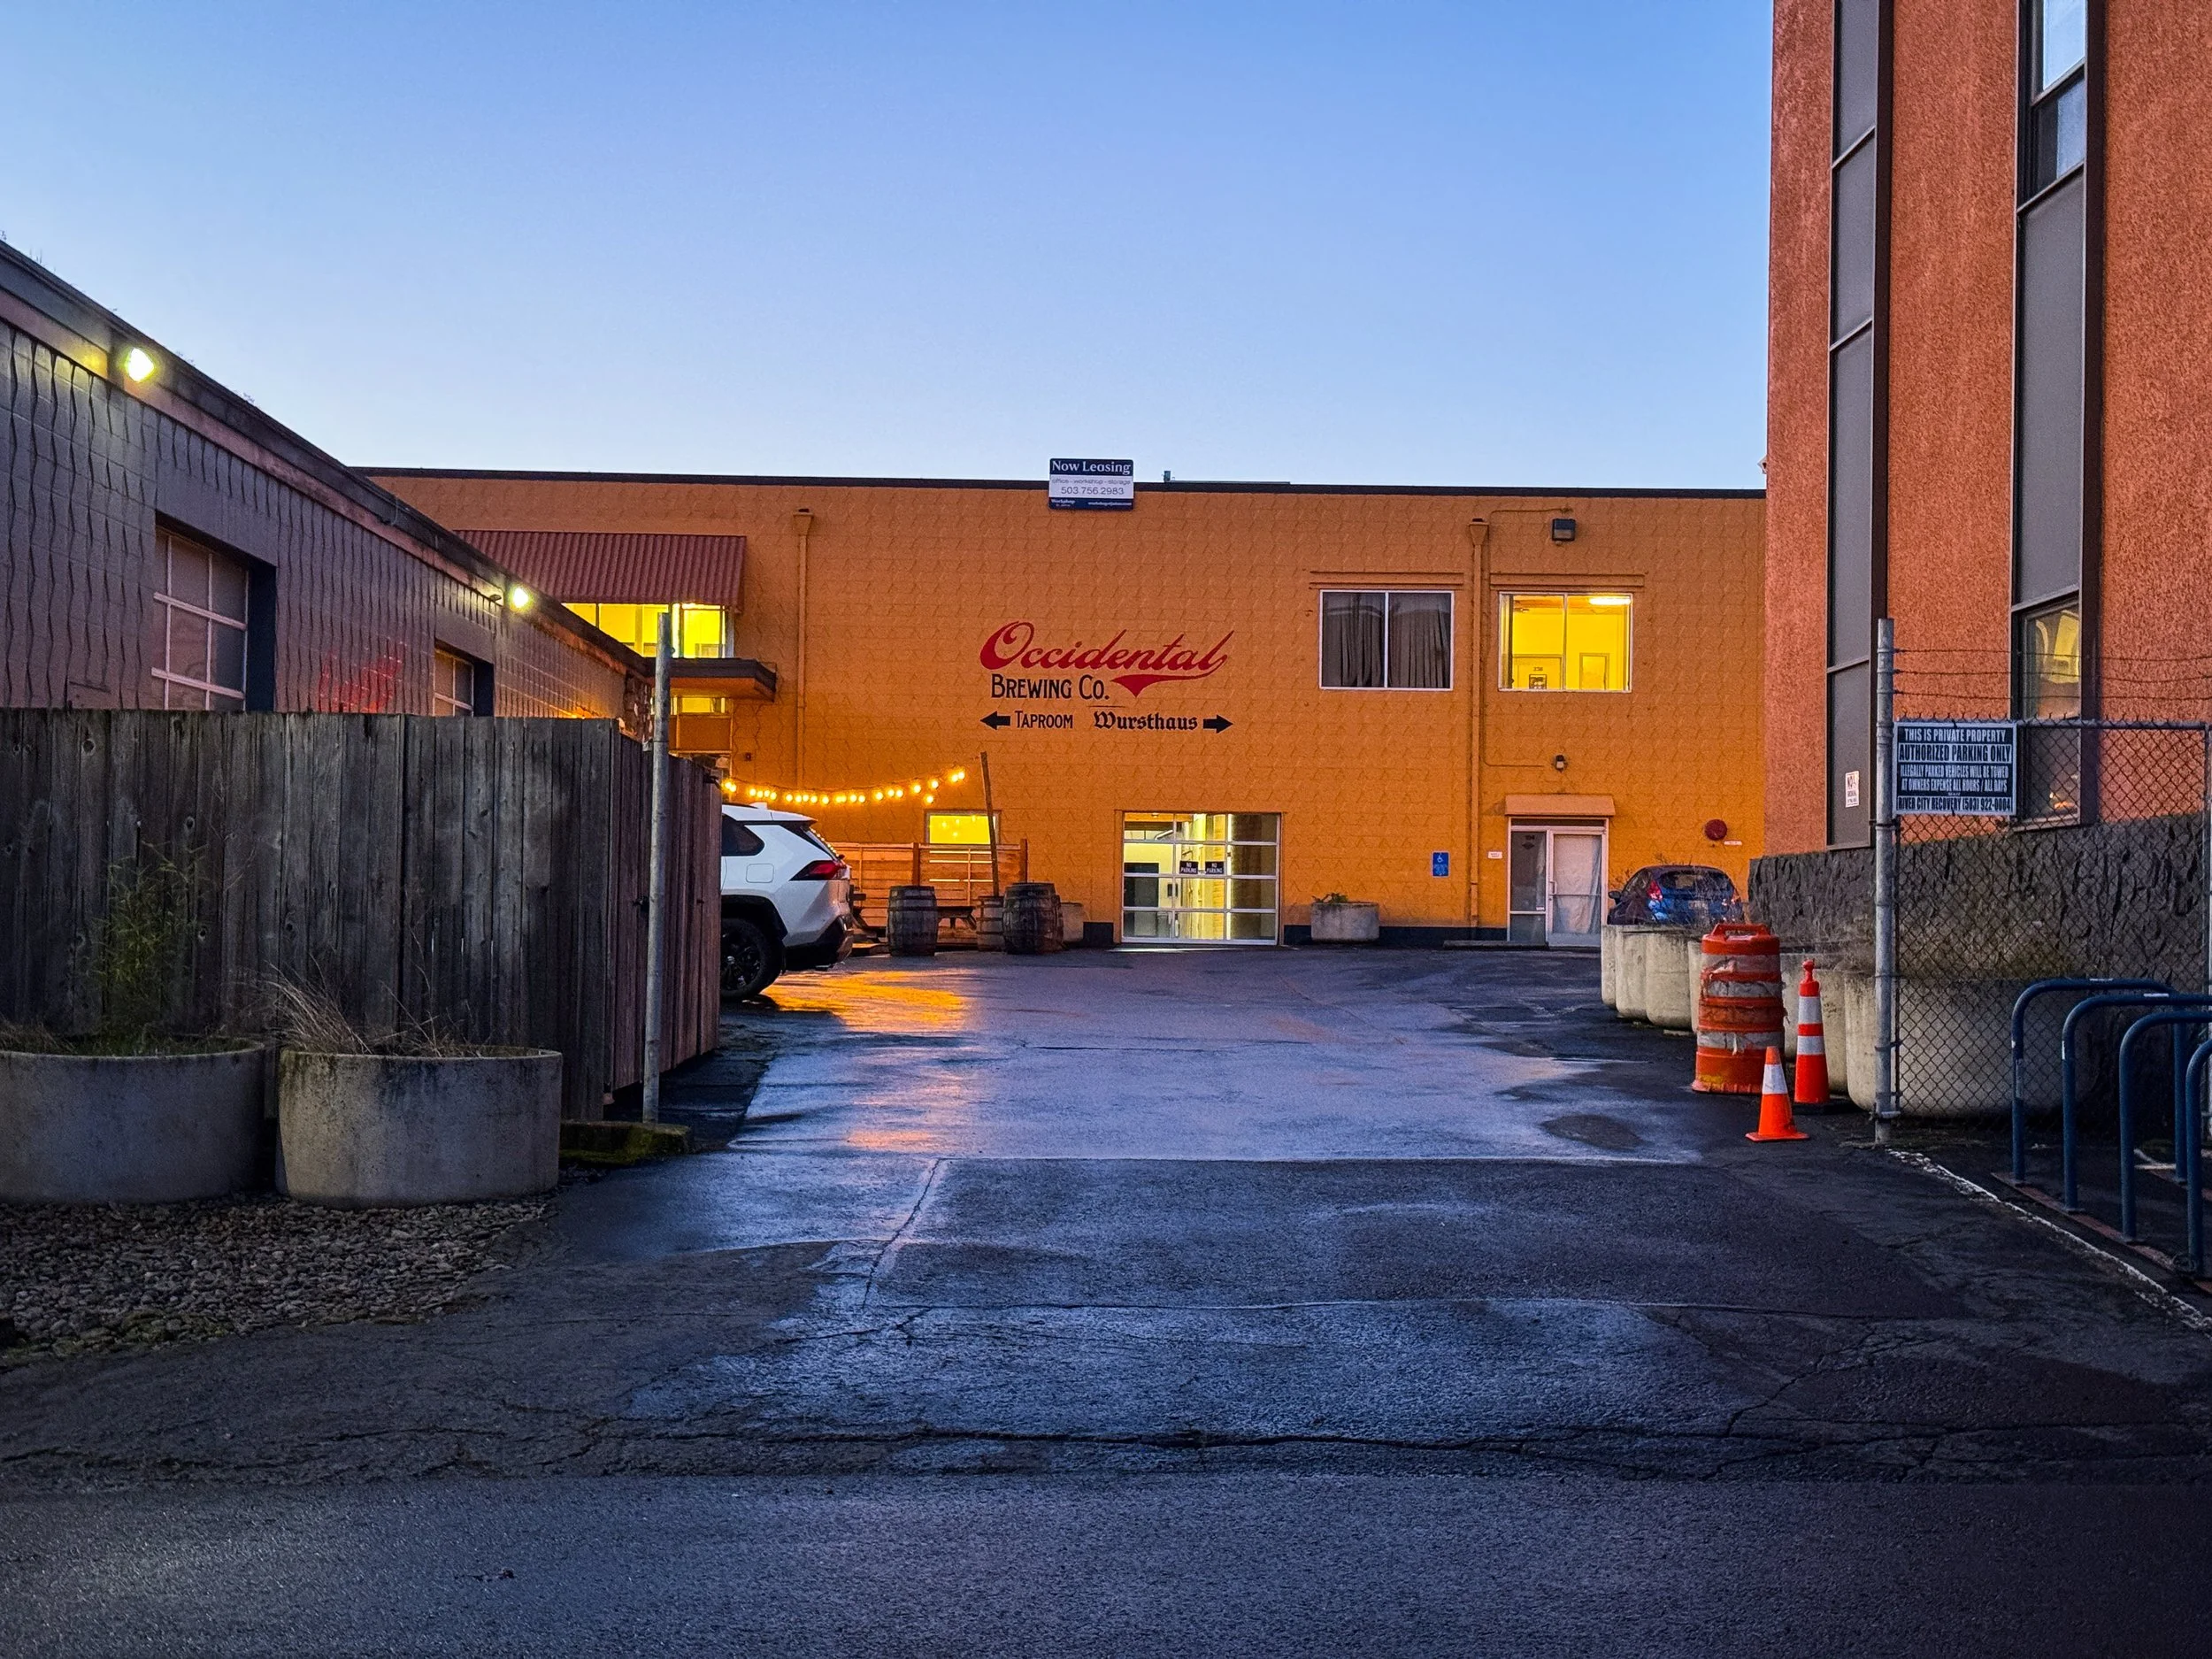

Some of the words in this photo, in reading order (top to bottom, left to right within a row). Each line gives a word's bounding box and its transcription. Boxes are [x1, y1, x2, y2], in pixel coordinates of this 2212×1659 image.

[1052, 460, 1079, 472] Now
[1082, 461, 1131, 475] Leasing
[979, 620, 1234, 672] Occidental
[991, 673, 1072, 699] BREWING
[1015, 710, 1073, 729] TAPROOM
[1094, 711, 1198, 731] Wursthaus
[1904, 728, 1922, 741] THIS
[1924, 728, 1932, 741] IS
[1933, 729, 1964, 742] PRIVATE
[1966, 729, 2006, 742] PROPERTY
[1899, 744, 1949, 761] AUTHORIZED
[1952, 745, 1988, 762] PARKING
[1990, 745, 2011, 762] ONLY
[1924, 764, 1945, 778] PARKED
[1945, 764, 1969, 778] VEHICLES
[1970, 765, 1982, 779] WILL
[1983, 765, 1990, 779] BE
[1990, 765, 2009, 779] TOWED
[1931, 779, 1952, 792] EXPENSE
[1953, 780, 1962, 792] ALL
[1985, 780, 1993, 792] ALL
[1898, 797, 1916, 810] RIVER
[1916, 797, 1931, 810] CITY
[1932, 797, 1962, 811] RECOVERY
